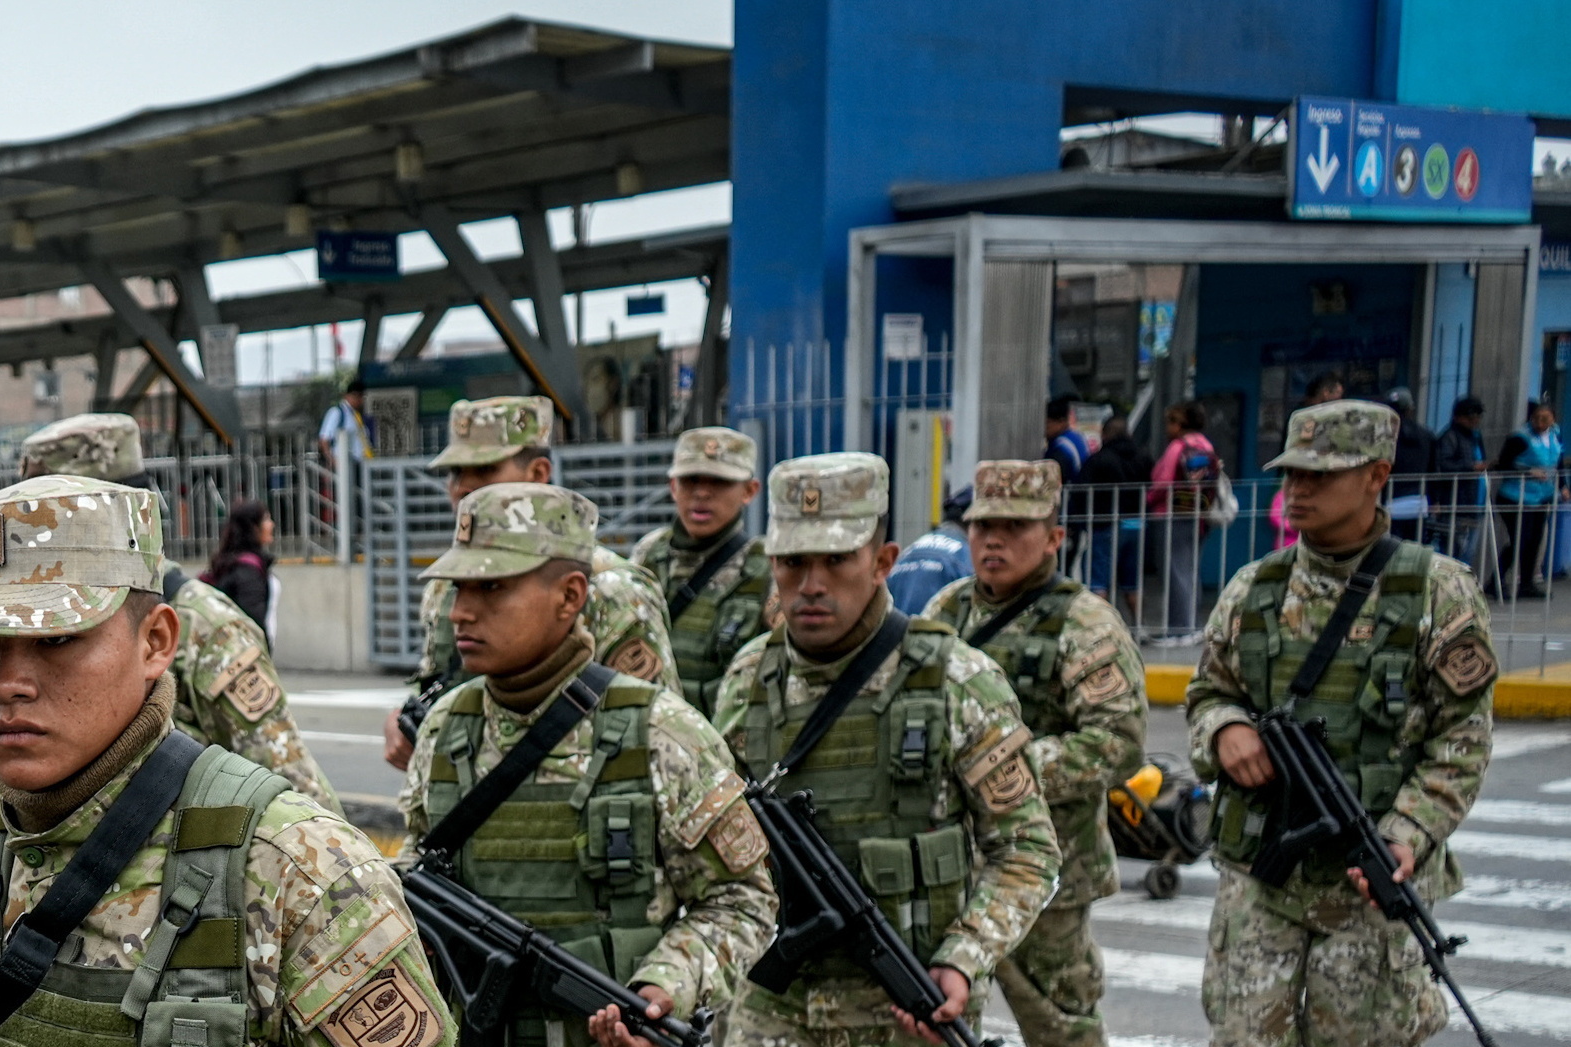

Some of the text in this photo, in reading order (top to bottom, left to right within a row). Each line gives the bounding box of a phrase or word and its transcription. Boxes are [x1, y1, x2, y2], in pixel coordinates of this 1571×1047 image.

[1308, 104, 1344, 125] Ingreso
[1359, 145, 1378, 187] A
[1397, 147, 1415, 193] 3
[1457, 153, 1473, 194] 4
